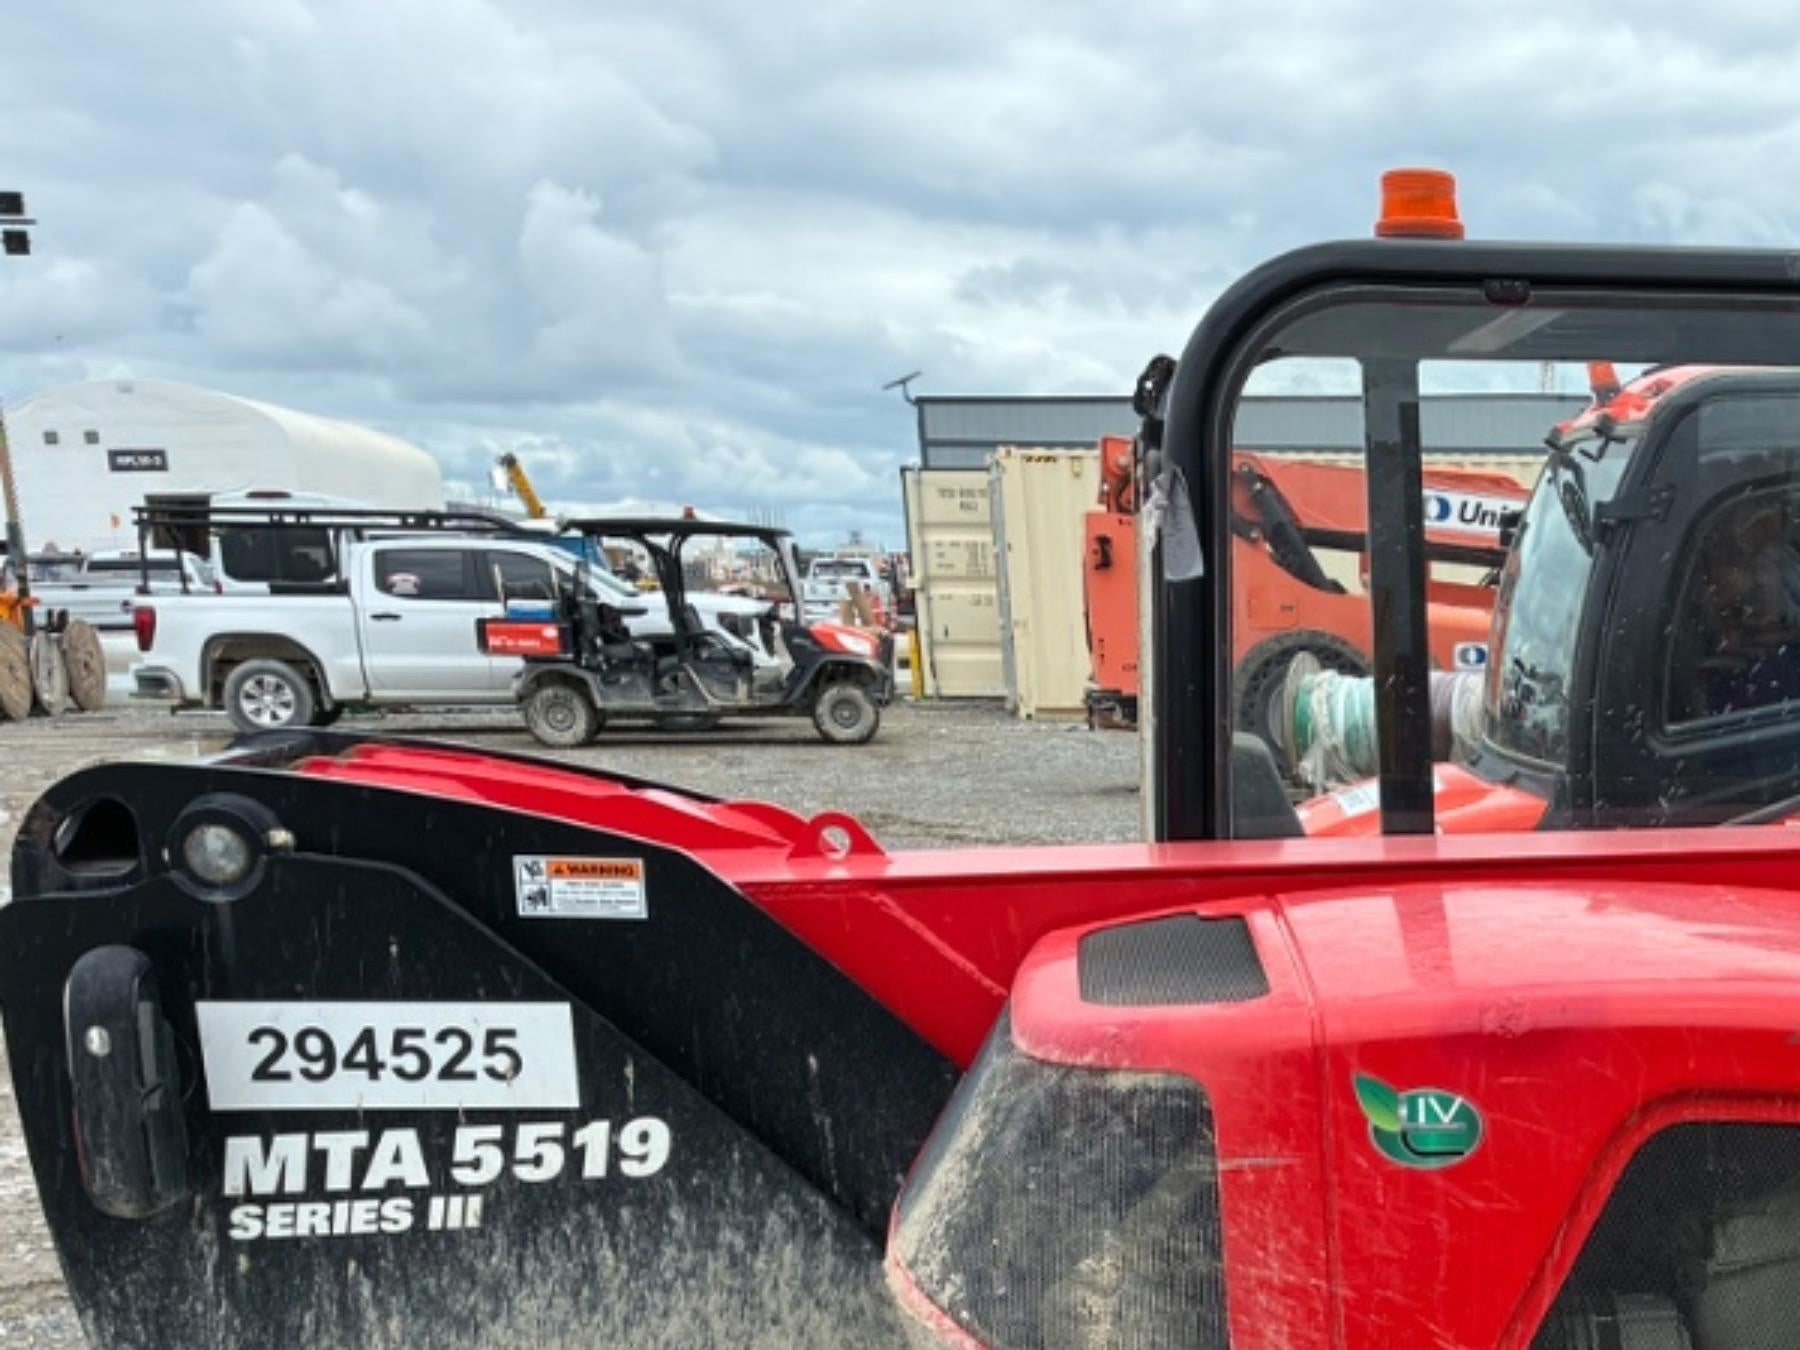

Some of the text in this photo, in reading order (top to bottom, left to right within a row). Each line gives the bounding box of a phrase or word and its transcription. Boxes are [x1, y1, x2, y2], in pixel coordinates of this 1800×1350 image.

[567, 863, 635, 877] WARNING
[246, 1026, 523, 1083] 294525
[223, 1116, 673, 1197] MTA 5519
[228, 1193, 484, 1241] SERIES III
